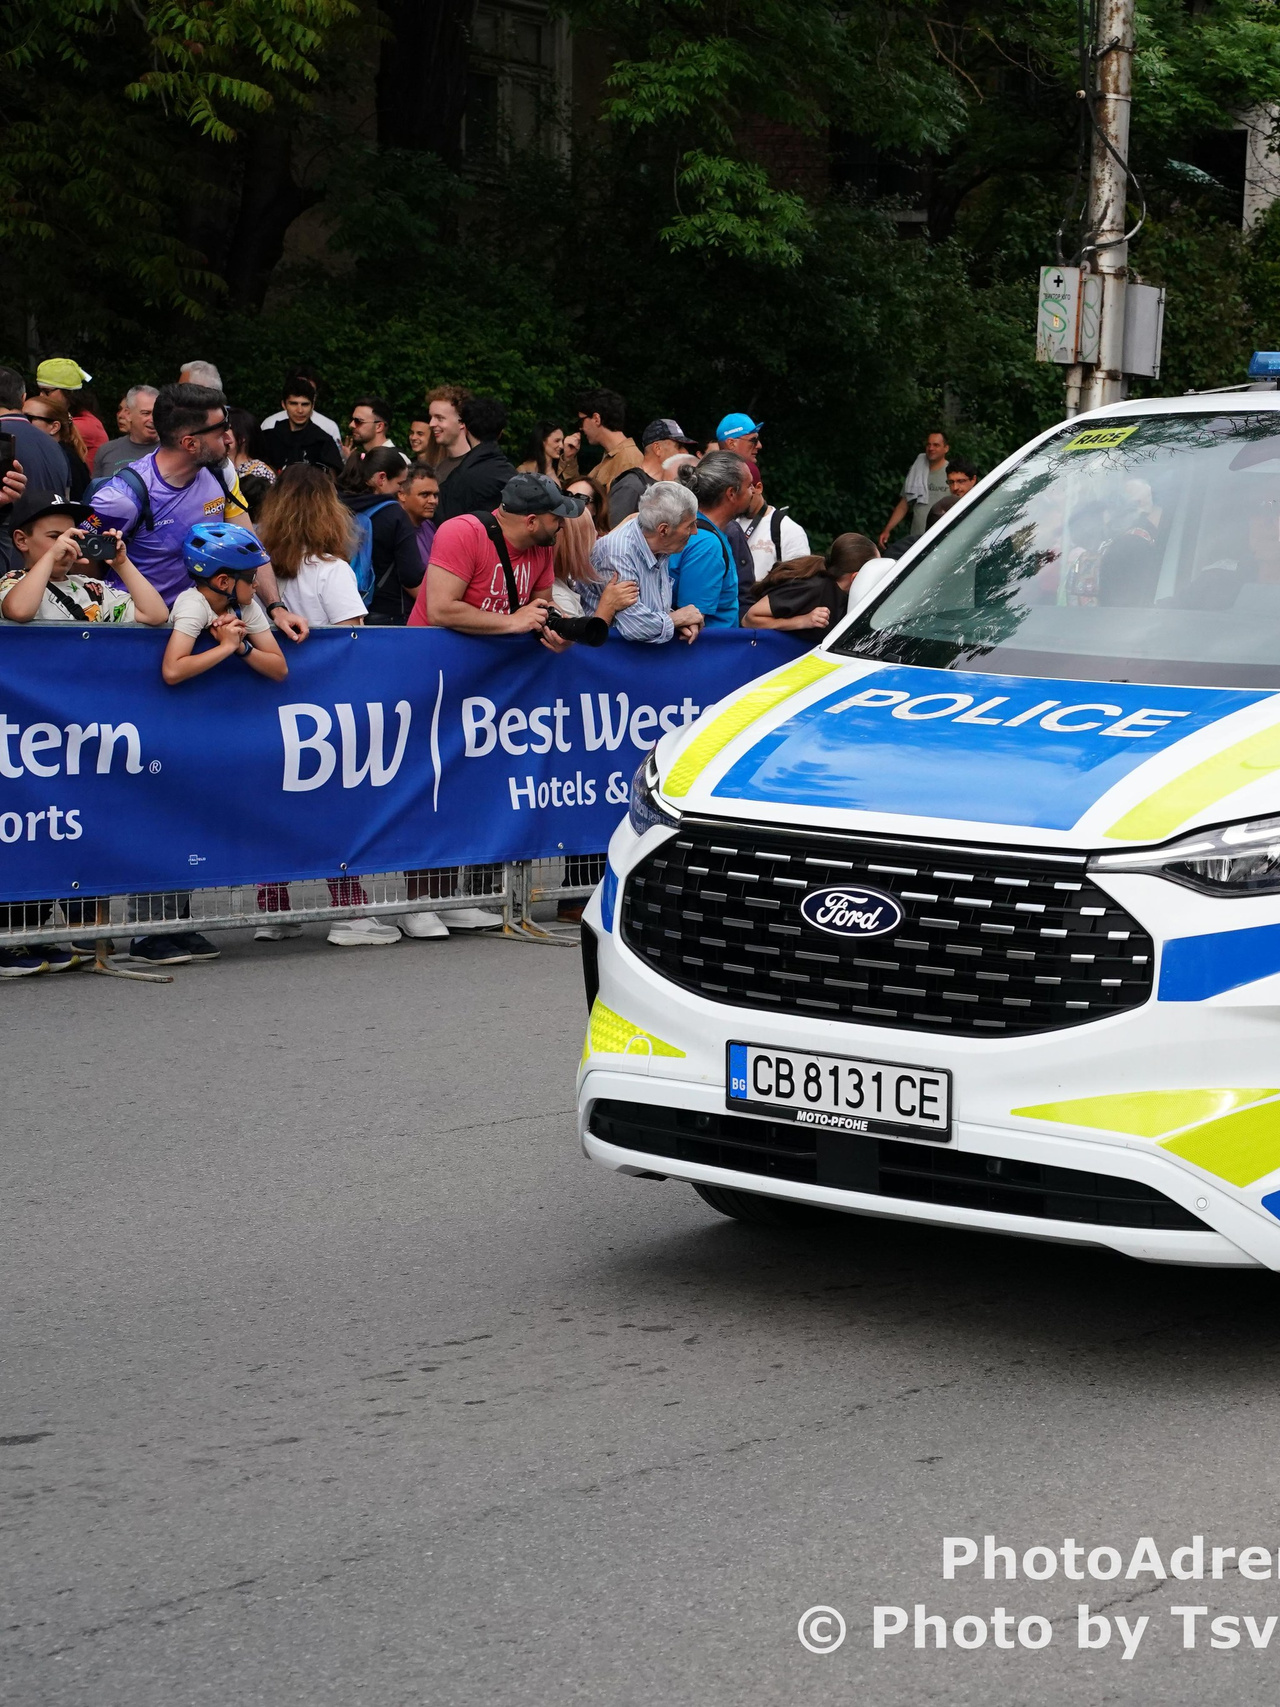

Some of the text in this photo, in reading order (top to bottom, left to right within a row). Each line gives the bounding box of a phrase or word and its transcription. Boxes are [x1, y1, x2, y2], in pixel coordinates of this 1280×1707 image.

[1074, 431, 1127, 446] RACE
[462, 692, 715, 757] Best West
[824, 688, 1192, 738] POLICE
[278, 699, 412, 792] BW
[508, 770, 630, 811] Hotels &
[815, 891, 881, 931] Ford
[732, 1077, 746, 1091] BG
[796, 1110, 869, 1132] MOTO-PFOHE
